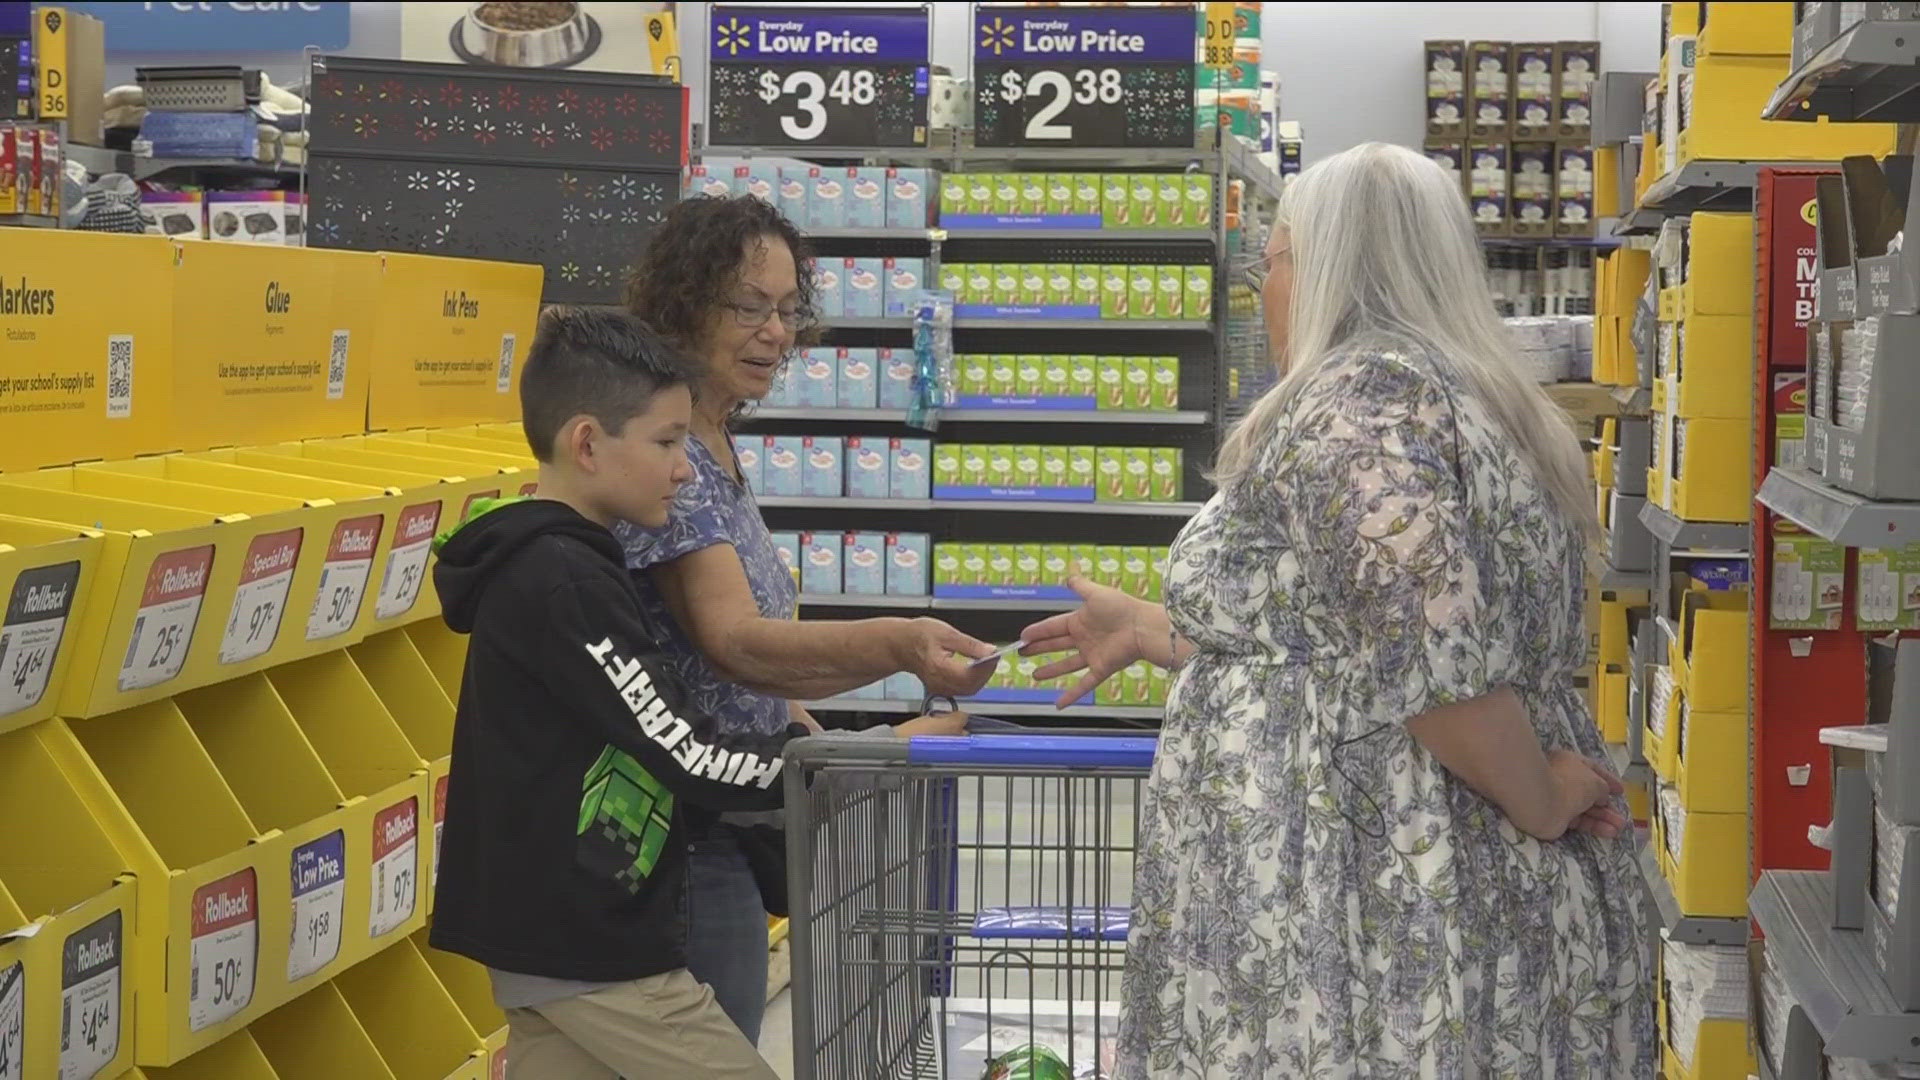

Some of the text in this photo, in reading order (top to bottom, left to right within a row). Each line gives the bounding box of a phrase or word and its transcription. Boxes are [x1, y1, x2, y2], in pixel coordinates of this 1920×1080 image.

[758, 21, 804, 32] Everyday
[1023, 20, 1069, 31] Everyday
[1221, 20, 1232, 39] D
[758, 30, 879, 54] Low Price
[1023, 29, 1146, 53] Low Price
[1205, 46, 1219, 64] 38
[1221, 46, 1233, 64] 38
[47, 69, 62, 88] D
[45, 94, 65, 112] 36
[265, 281, 290, 313] Glue
[443, 290, 479, 318] Ink Pens
[10, 378, 29, 398] your
[30, 372, 59, 391] school's
[60, 372, 83, 394] supply
[84, 371, 95, 389] list
[229, 362, 238, 378] the
[239, 366, 249, 382] app
[255, 364, 265, 381] get
[405, 512, 437, 538] Rollback
[339, 528, 374, 553] Rollback
[252, 545, 296, 578] Special Buy
[160, 562, 206, 595] Rollback
[24, 582, 67, 614] Rollback
[585, 636, 784, 790] MINECRAFT
[385, 807, 415, 846] Rollback
[298, 855, 339, 890] Low Price
[205, 887, 249, 924] Rollback
[78, 931, 114, 973] Rollback
